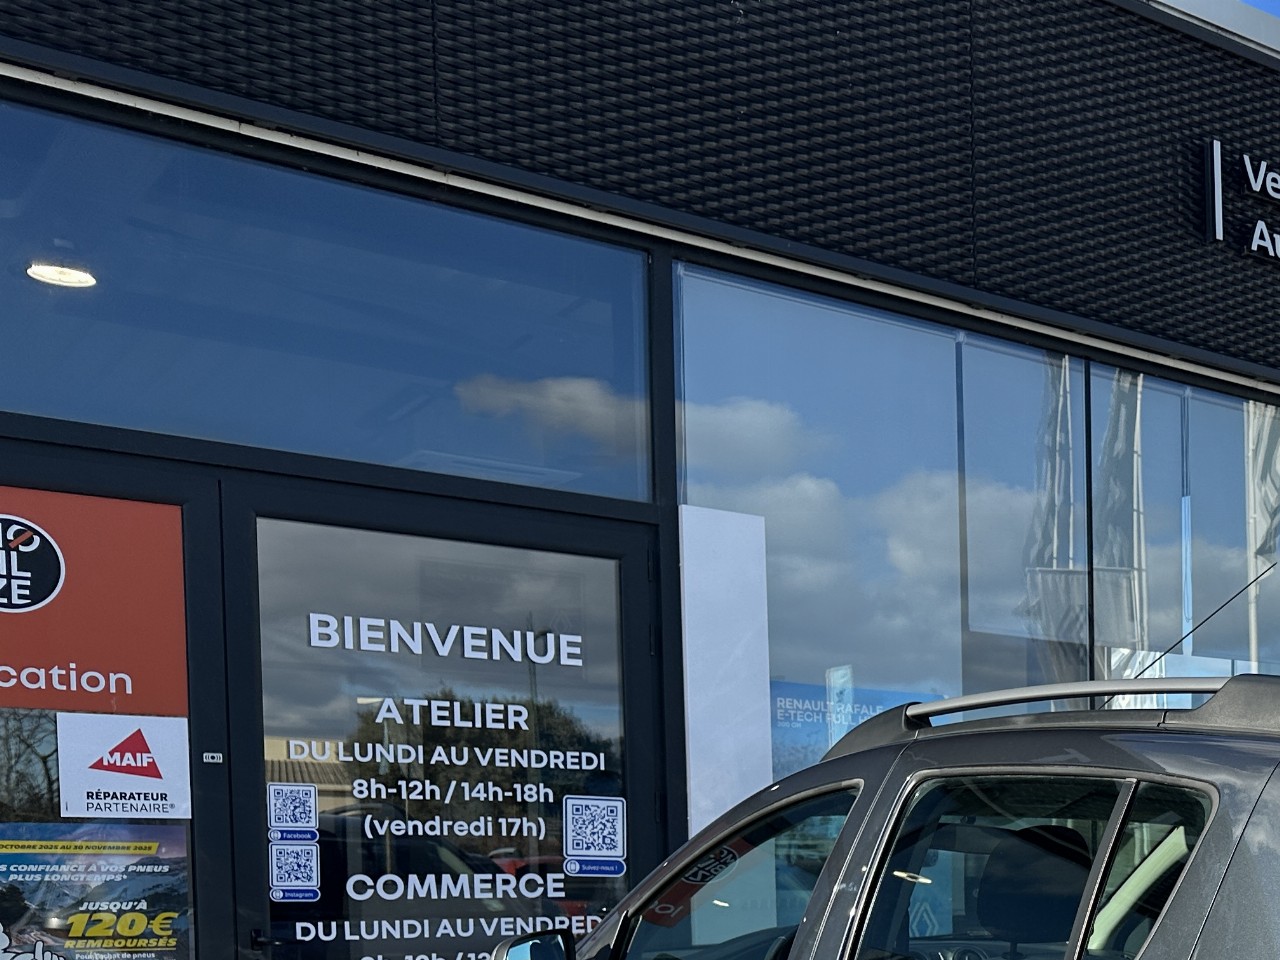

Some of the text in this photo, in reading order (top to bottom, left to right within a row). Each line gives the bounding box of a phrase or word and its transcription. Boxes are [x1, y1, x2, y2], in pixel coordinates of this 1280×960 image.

[309, 612, 583, 667] BIENVENUE
[375, 697, 530, 731] ATELIER
[777, 709, 822, 723] E-TECH
[102, 752, 154, 767] MAIF
[289, 740, 606, 771] DU LUNDI AU VENDREDI
[86, 789, 168, 801] RÉPARATEUR
[352, 778, 554, 804] 8h-12h / 14h-18h
[364, 814, 547, 841] (vendredi 17h)
[283, 832, 312, 840] Facebook
[9, 864, 87, 872] CONFIANCE
[100, 864, 127, 873] VOS
[128, 865, 170, 873] PNEUS
[8, 874, 42, 882] PLUS
[346, 873, 566, 901] COMMERCE
[284, 891, 314, 900] Instagram
[66, 912, 179, 937] 120€
[295, 915, 603, 942] DU LUNDI AU VENDRED
[64, 937, 177, 949] REMBOURSÉS
[132, 953, 155, 960] pneus
